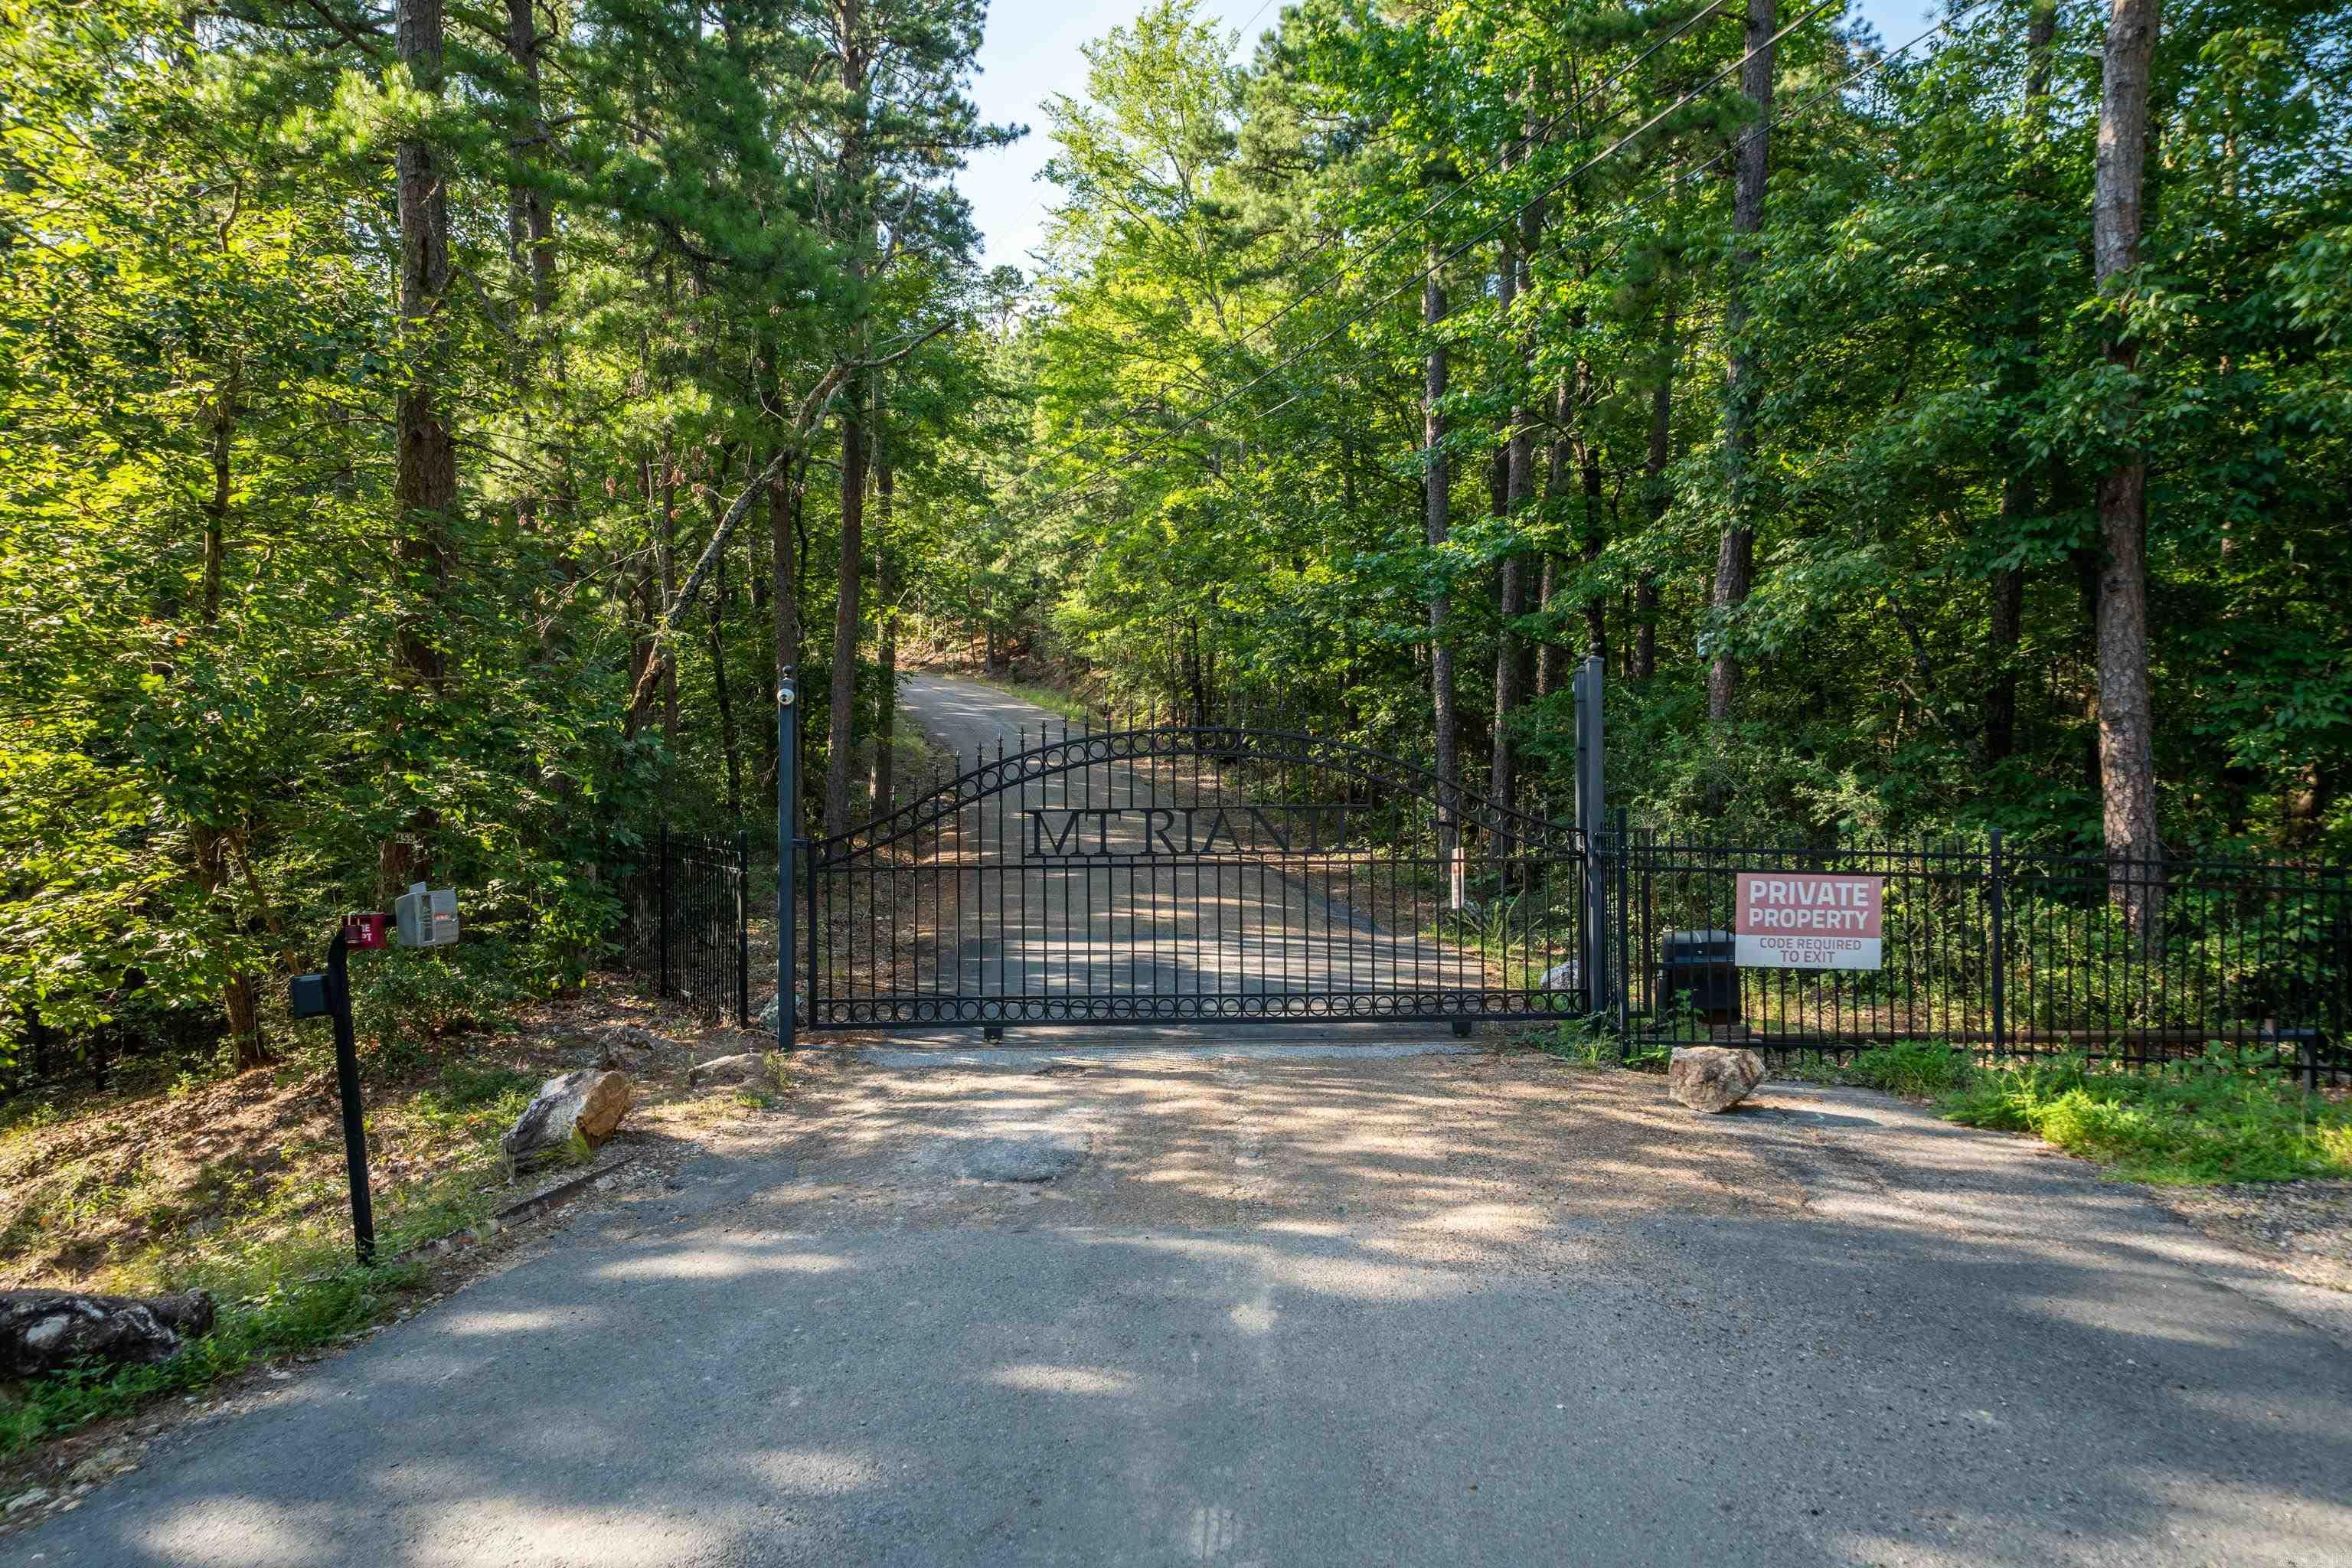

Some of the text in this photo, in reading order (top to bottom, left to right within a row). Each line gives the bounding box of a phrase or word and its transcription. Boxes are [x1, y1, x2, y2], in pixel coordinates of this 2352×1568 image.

[1749, 880, 1870, 907] PRIVATE
[1749, 907, 1869, 930] PROPERTY
[1759, 937, 1862, 951] CODE REQUIRED
[1780, 949, 1836, 963] TO EXIT
